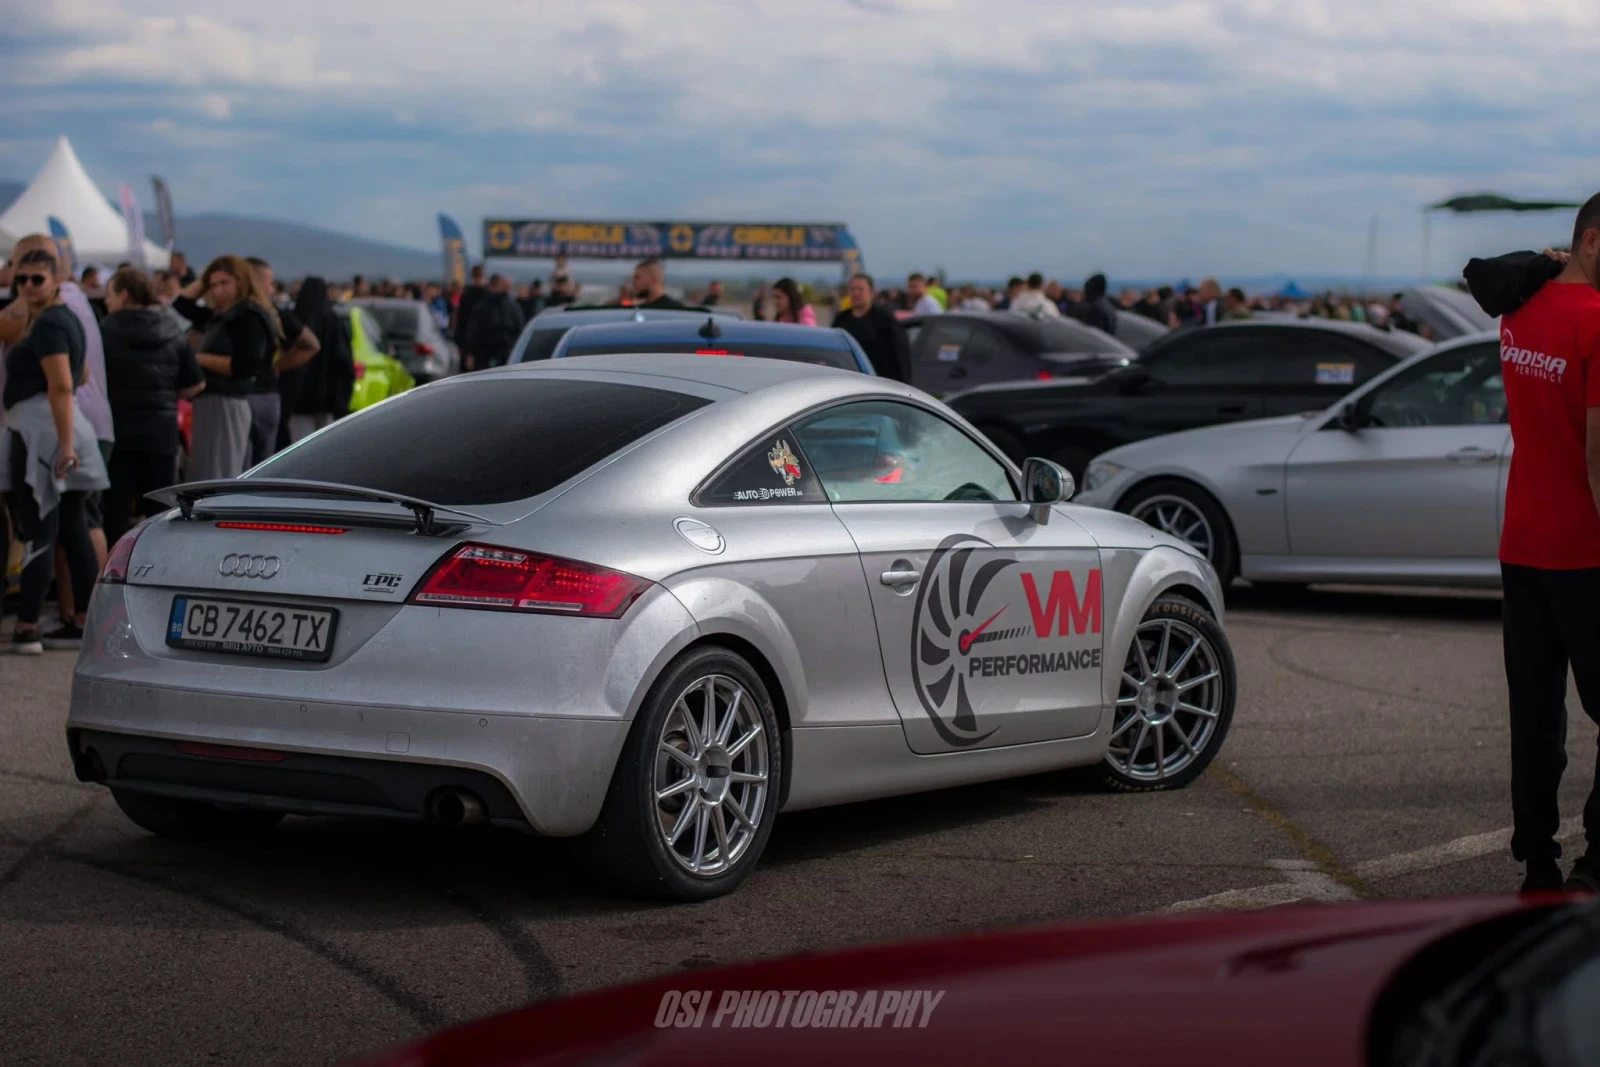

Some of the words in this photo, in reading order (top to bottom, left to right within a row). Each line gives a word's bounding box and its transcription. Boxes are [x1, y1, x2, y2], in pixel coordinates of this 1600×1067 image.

[737, 489, 759, 500] AUTO
[362, 574, 402, 588] EPC
[1019, 568, 1100, 638] VM
[187, 604, 219, 637] CB
[222, 607, 285, 644] 7462
[292, 613, 325, 648] TX
[968, 648, 1101, 678] PERFORMANCE
